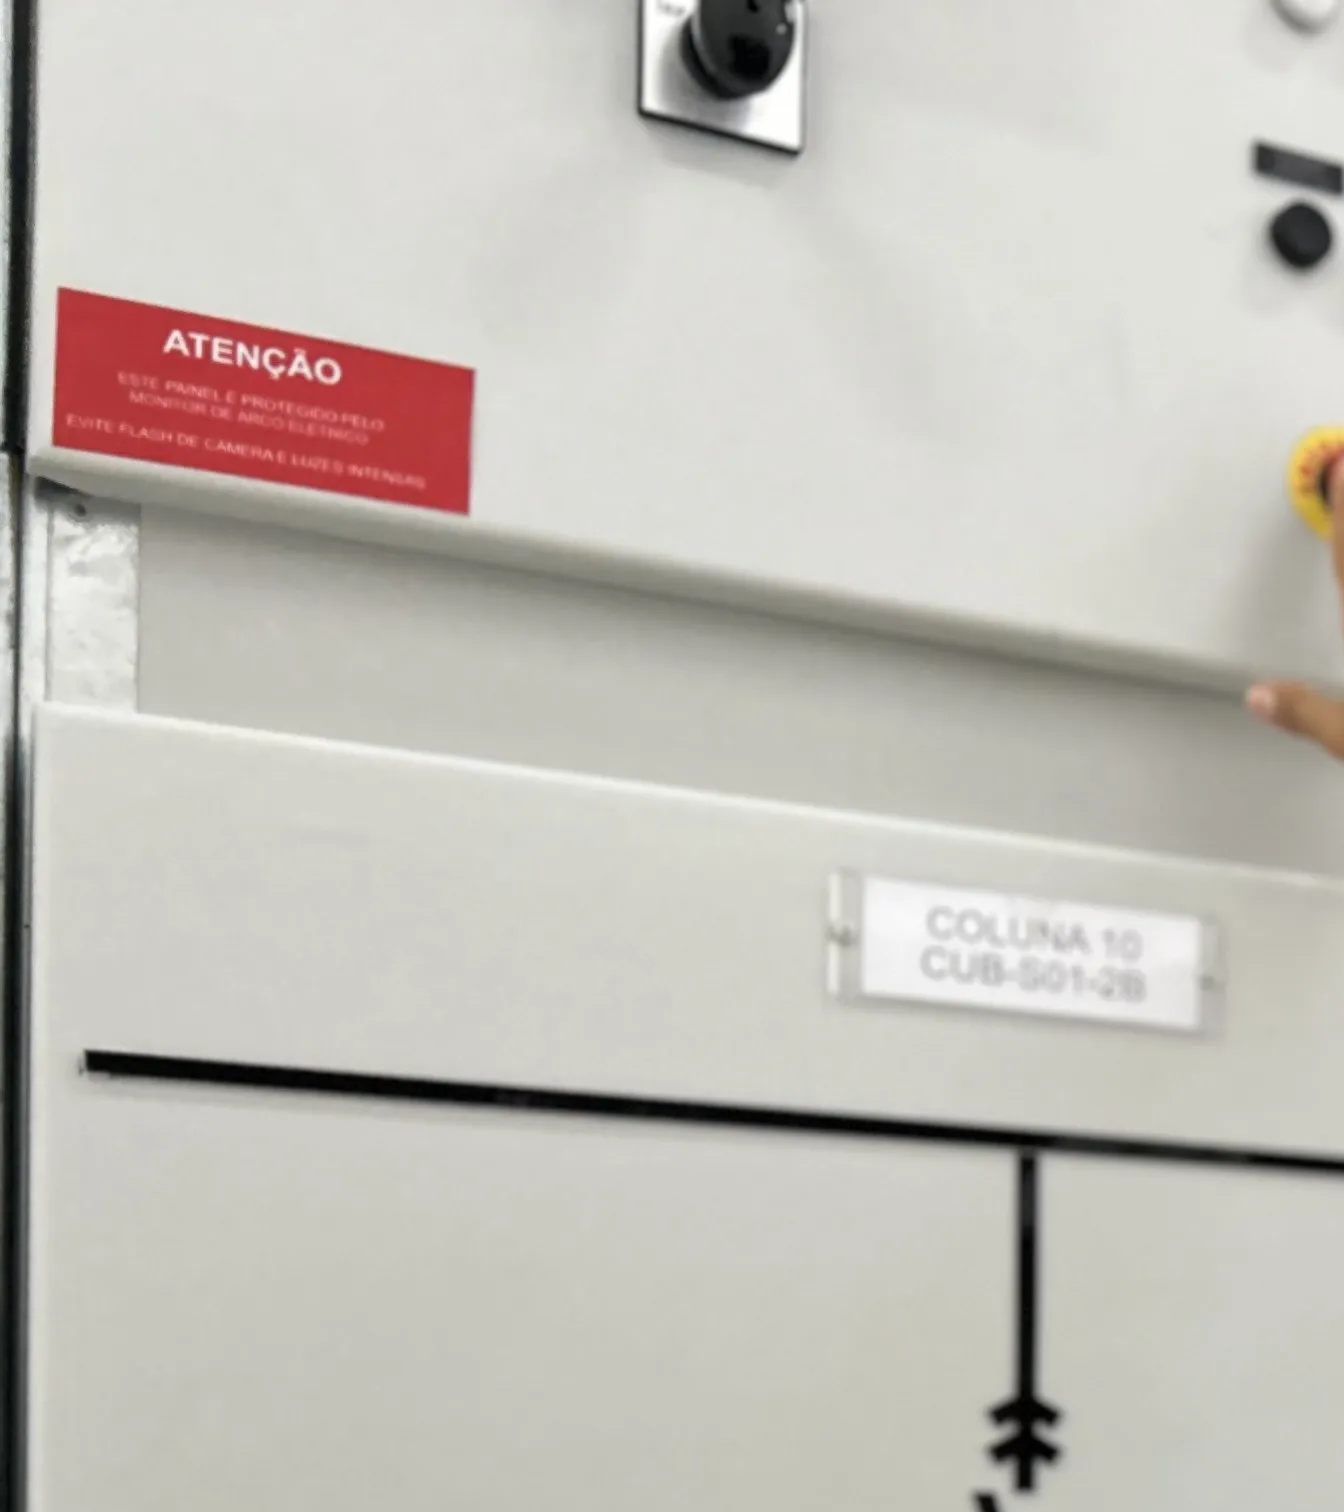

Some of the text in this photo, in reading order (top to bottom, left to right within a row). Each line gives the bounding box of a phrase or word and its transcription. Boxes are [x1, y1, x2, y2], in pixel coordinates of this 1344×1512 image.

[163, 330, 342, 385] ATENÇÃO
[925, 904, 1144, 964] COLUNA 10
